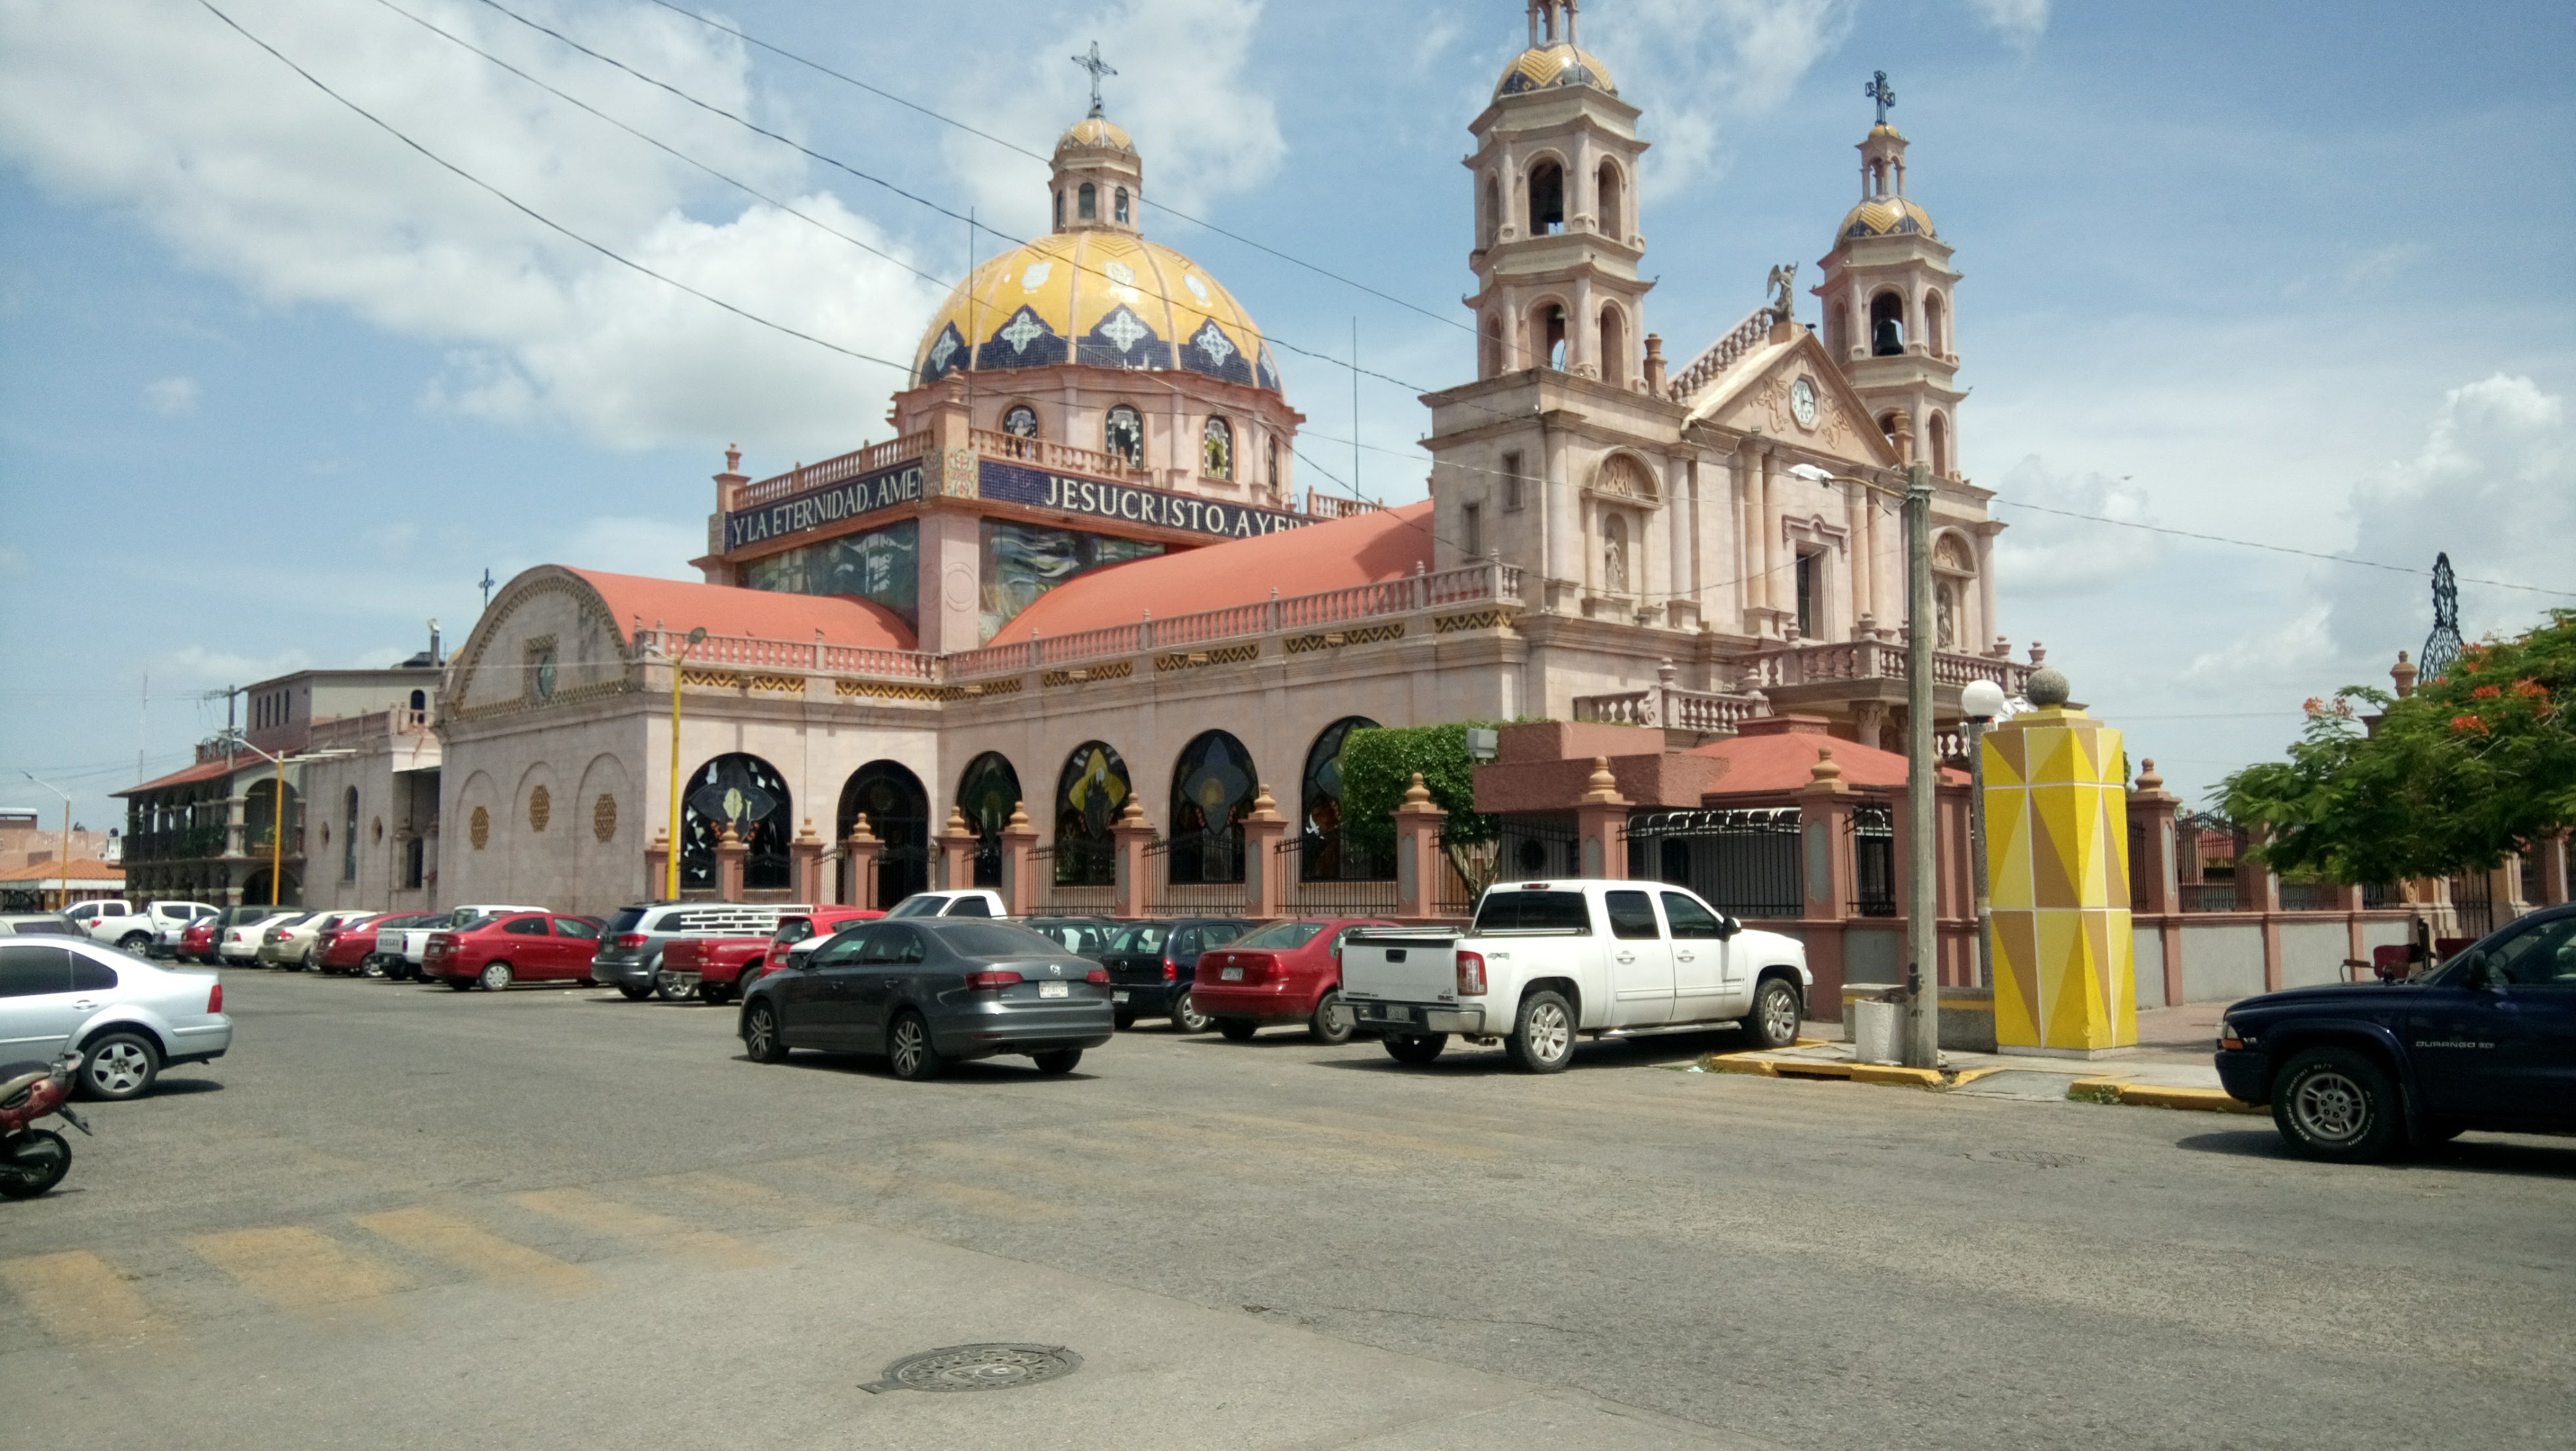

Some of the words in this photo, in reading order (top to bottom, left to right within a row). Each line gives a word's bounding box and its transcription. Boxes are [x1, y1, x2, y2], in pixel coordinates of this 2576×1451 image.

[734, 518, 746, 545] Y
[748, 513, 768, 542] LA
[773, 484, 873, 536] ETERNIDAD,
[1046, 476, 1229, 536] JESUCRISTO,
